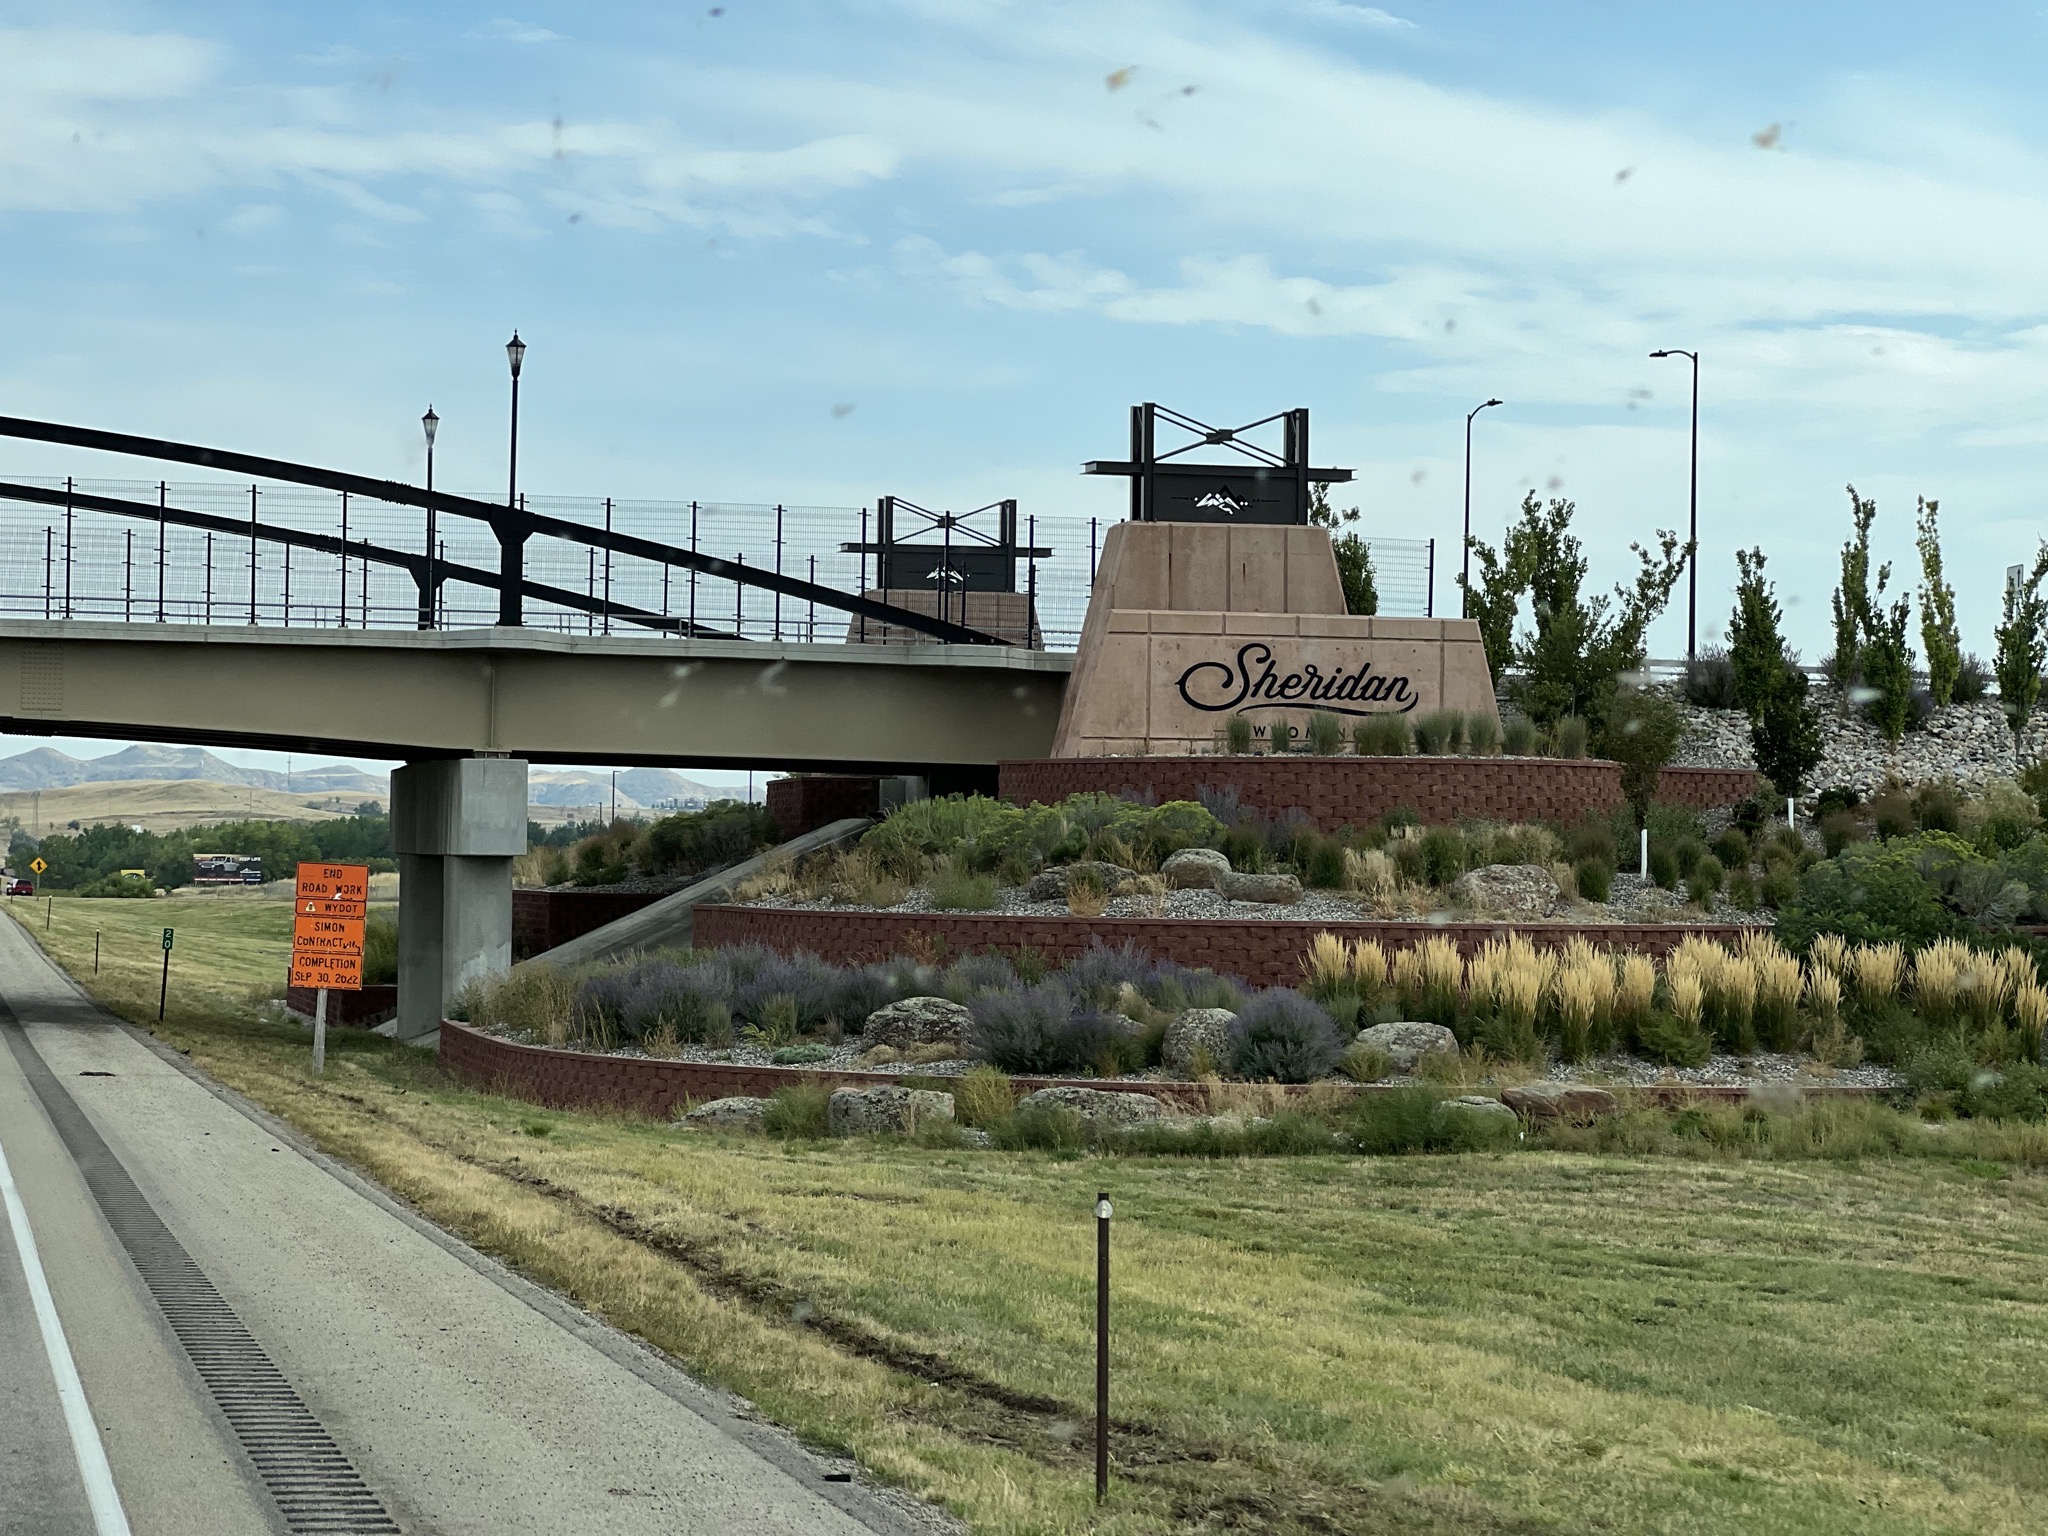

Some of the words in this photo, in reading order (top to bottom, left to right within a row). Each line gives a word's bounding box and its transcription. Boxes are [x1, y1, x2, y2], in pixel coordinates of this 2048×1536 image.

[1175, 643, 1418, 716] Sheridan
[323, 869, 343, 879] END
[302, 882, 328, 893] ROAD
[335, 884, 362, 895] WORK
[325, 903, 358, 913] WYDOT
[314, 922, 345, 933] SIMON
[299, 956, 356, 969] COMPLETION
[294, 971, 312, 982] SEP
[335, 973, 359, 985] 2022
